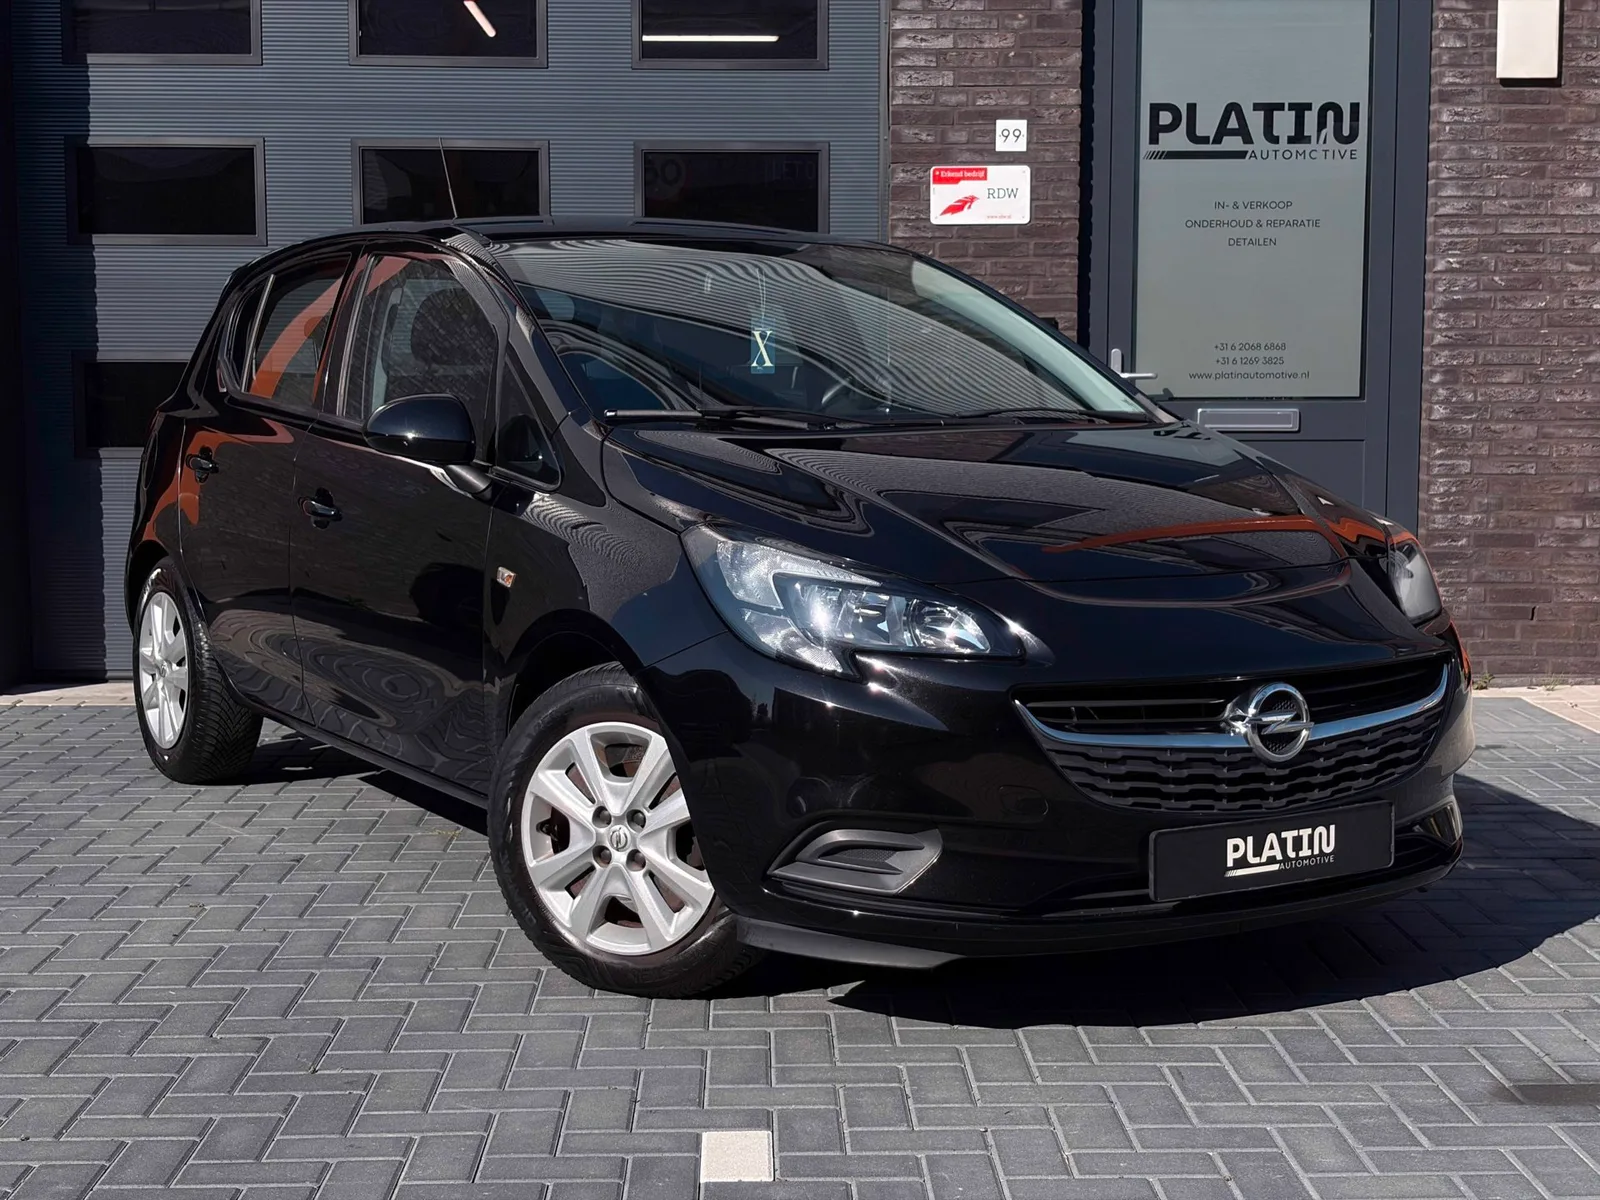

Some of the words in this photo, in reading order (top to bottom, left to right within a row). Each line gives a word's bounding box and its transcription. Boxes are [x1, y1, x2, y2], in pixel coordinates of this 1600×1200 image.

[1148, 101, 1361, 145] PLATIN
[1000, 128, 1022, 143] 99
[987, 187, 1019, 200] RDW
[1214, 200, 1230, 210] IN-
[1231, 200, 1240, 210] &
[1242, 200, 1293, 210] VERKOOP
[1185, 219, 1253, 229] ONDERHOUD
[1255, 219, 1263, 229] &
[1266, 218, 1321, 228] REPARATIE
[1228, 237, 1277, 247] DETAILEN
[1214, 342, 1228, 352] +31
[1230, 342, 1237, 352] 6
[1238, 342, 1262, 352] 2068
[1263, 342, 1287, 352] 6868
[1215, 356, 1229, 366] +31
[1231, 356, 1238, 366] 6
[1239, 356, 1260, 366] 1269
[1261, 356, 1285, 366] 3825
[1188, 370, 1310, 381] www.platinautomotive.nl
[1226, 824, 1336, 868] PLATIN
[1279, 854, 1335, 870] AUTOMOTIVE
